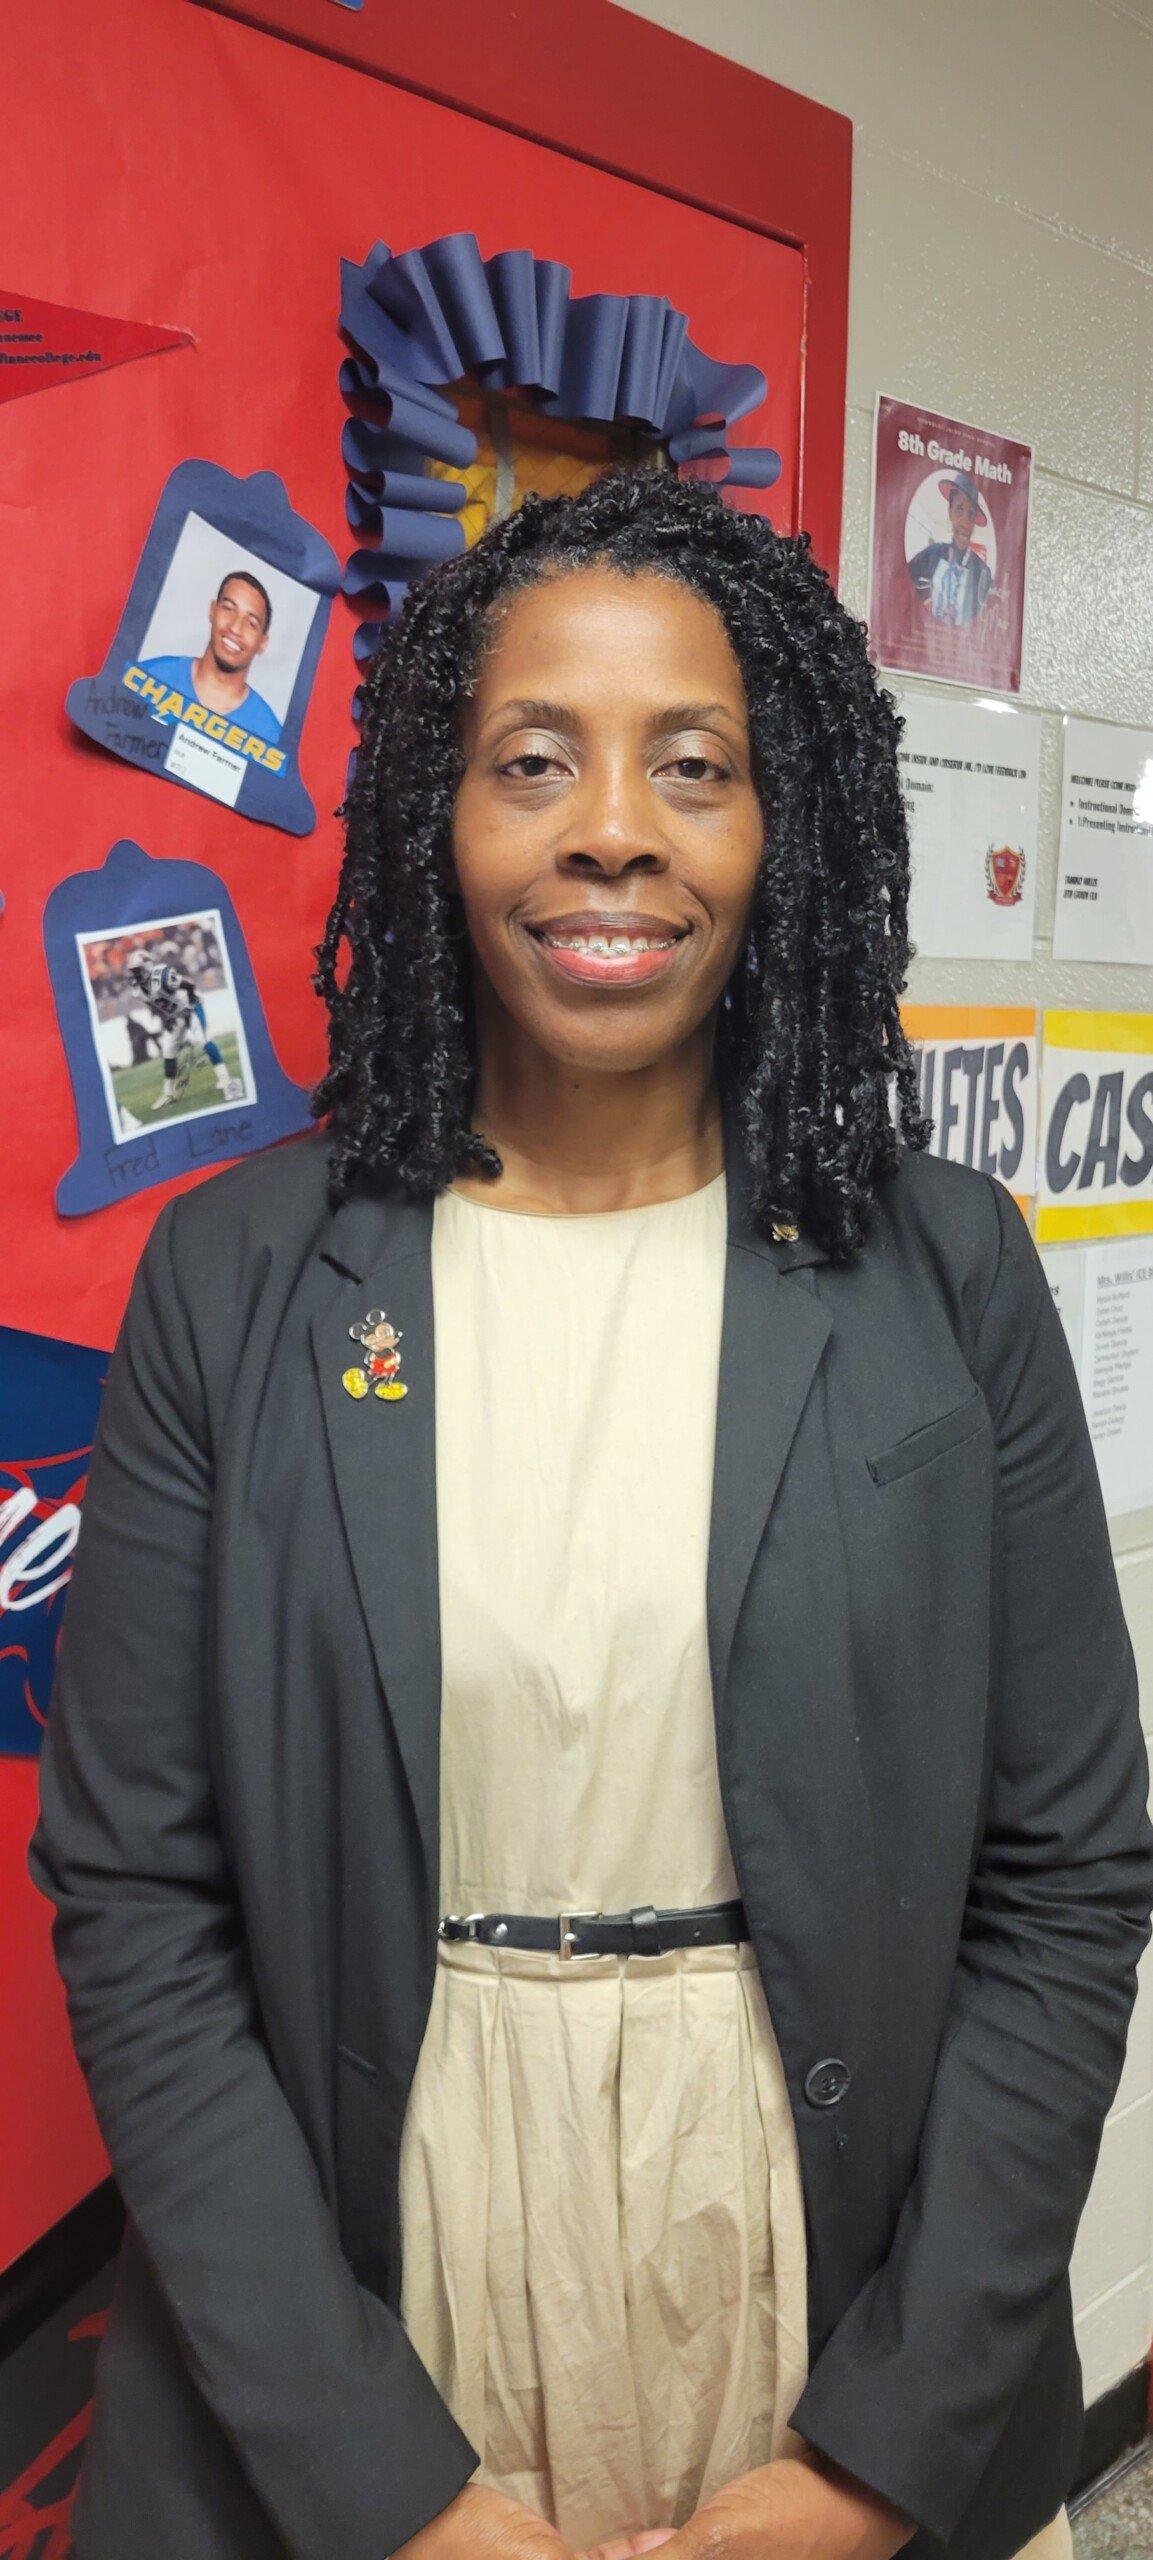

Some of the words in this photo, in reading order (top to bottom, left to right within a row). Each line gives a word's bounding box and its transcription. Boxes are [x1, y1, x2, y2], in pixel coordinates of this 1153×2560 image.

[897, 430, 925, 457] 8th
[927, 440, 972, 472] Grade
[974, 455, 1012, 485] Math
[122, 666, 287, 772] CHARGERS
[179, 733, 211, 756] Andrew
[212, 750, 241, 774] Farmer
[102, 1134, 160, 1188] Fred
[186, 1120, 252, 1158] Lane
